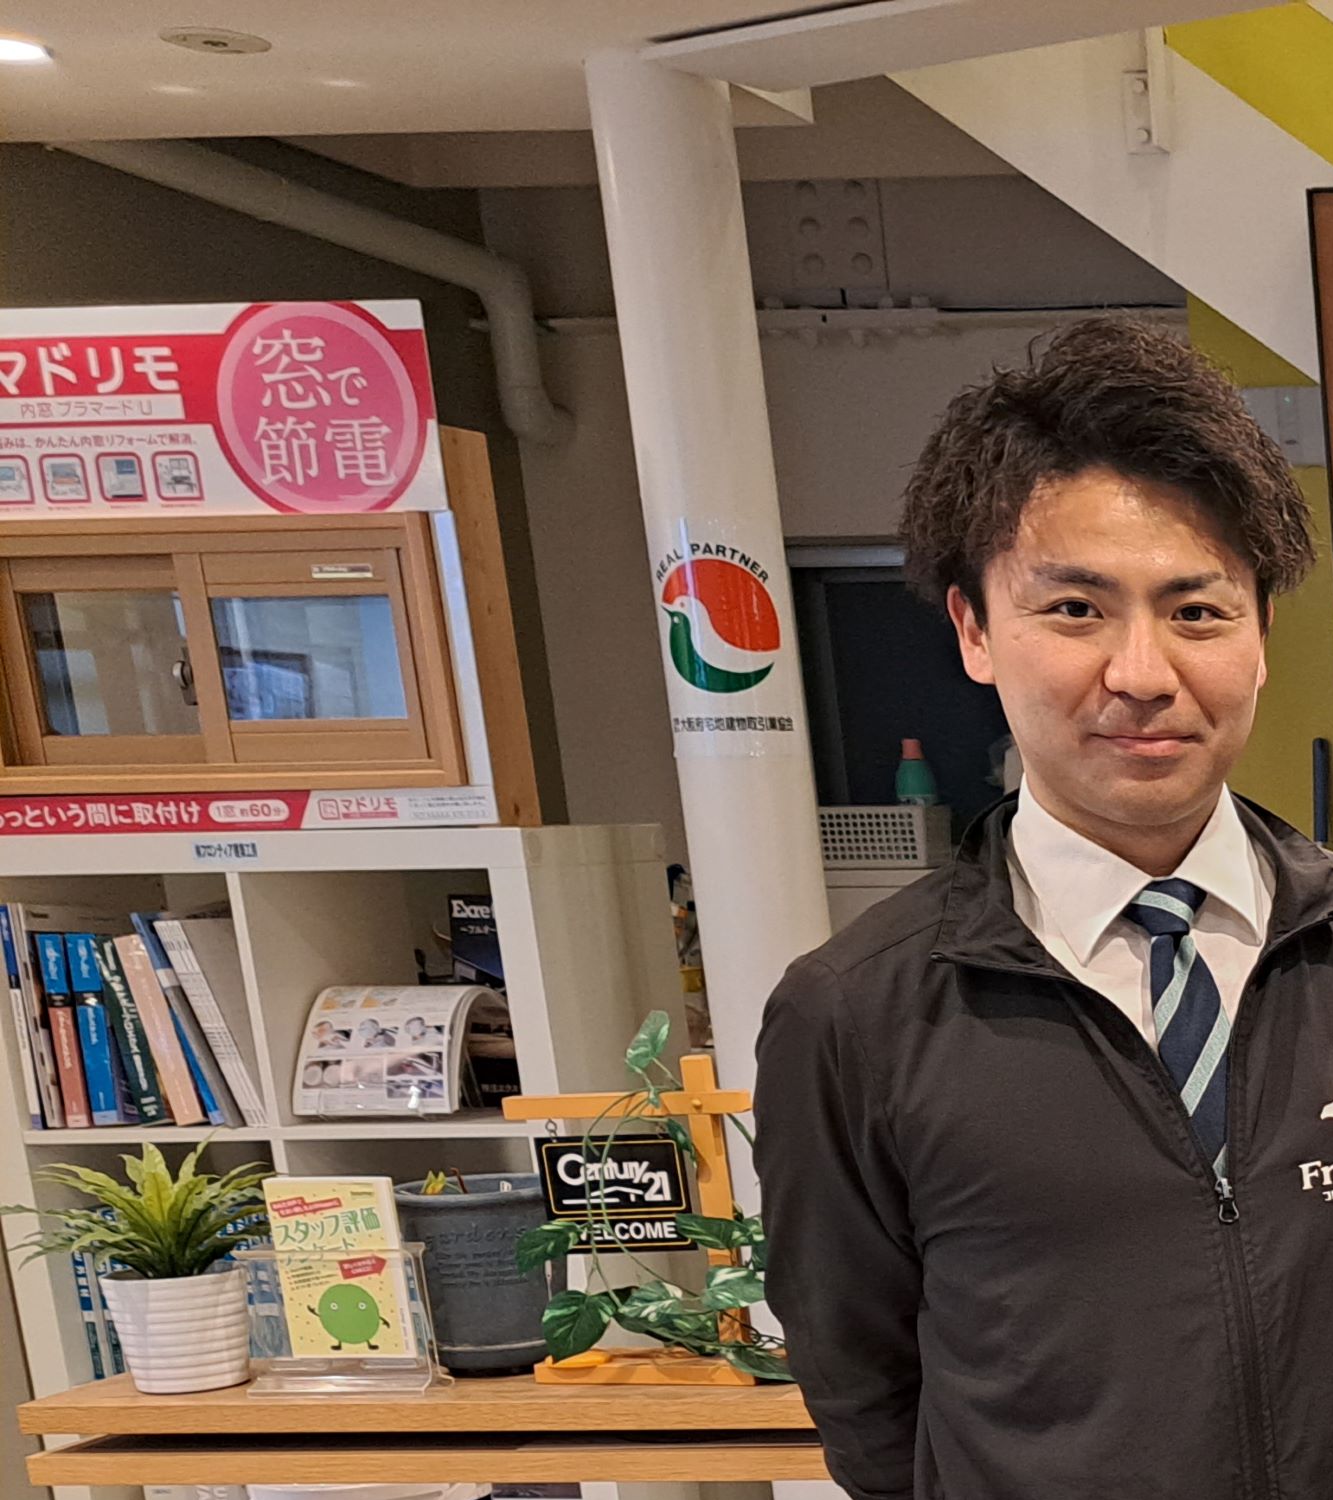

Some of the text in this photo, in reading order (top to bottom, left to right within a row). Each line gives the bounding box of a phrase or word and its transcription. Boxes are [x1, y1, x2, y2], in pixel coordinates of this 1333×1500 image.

[0, 342, 181, 396] マドリモ
[253, 328, 370, 413] 窓で
[254, 415, 399, 489] 節電
[656, 543, 769, 583] REAL PARTNER
[342, 797, 396, 811] マドリモ
[557, 1153, 672, 1201] Century 21
[275, 1207, 381, 1246] スタッフ評価
[579, 1221, 678, 1242] ELCOME
